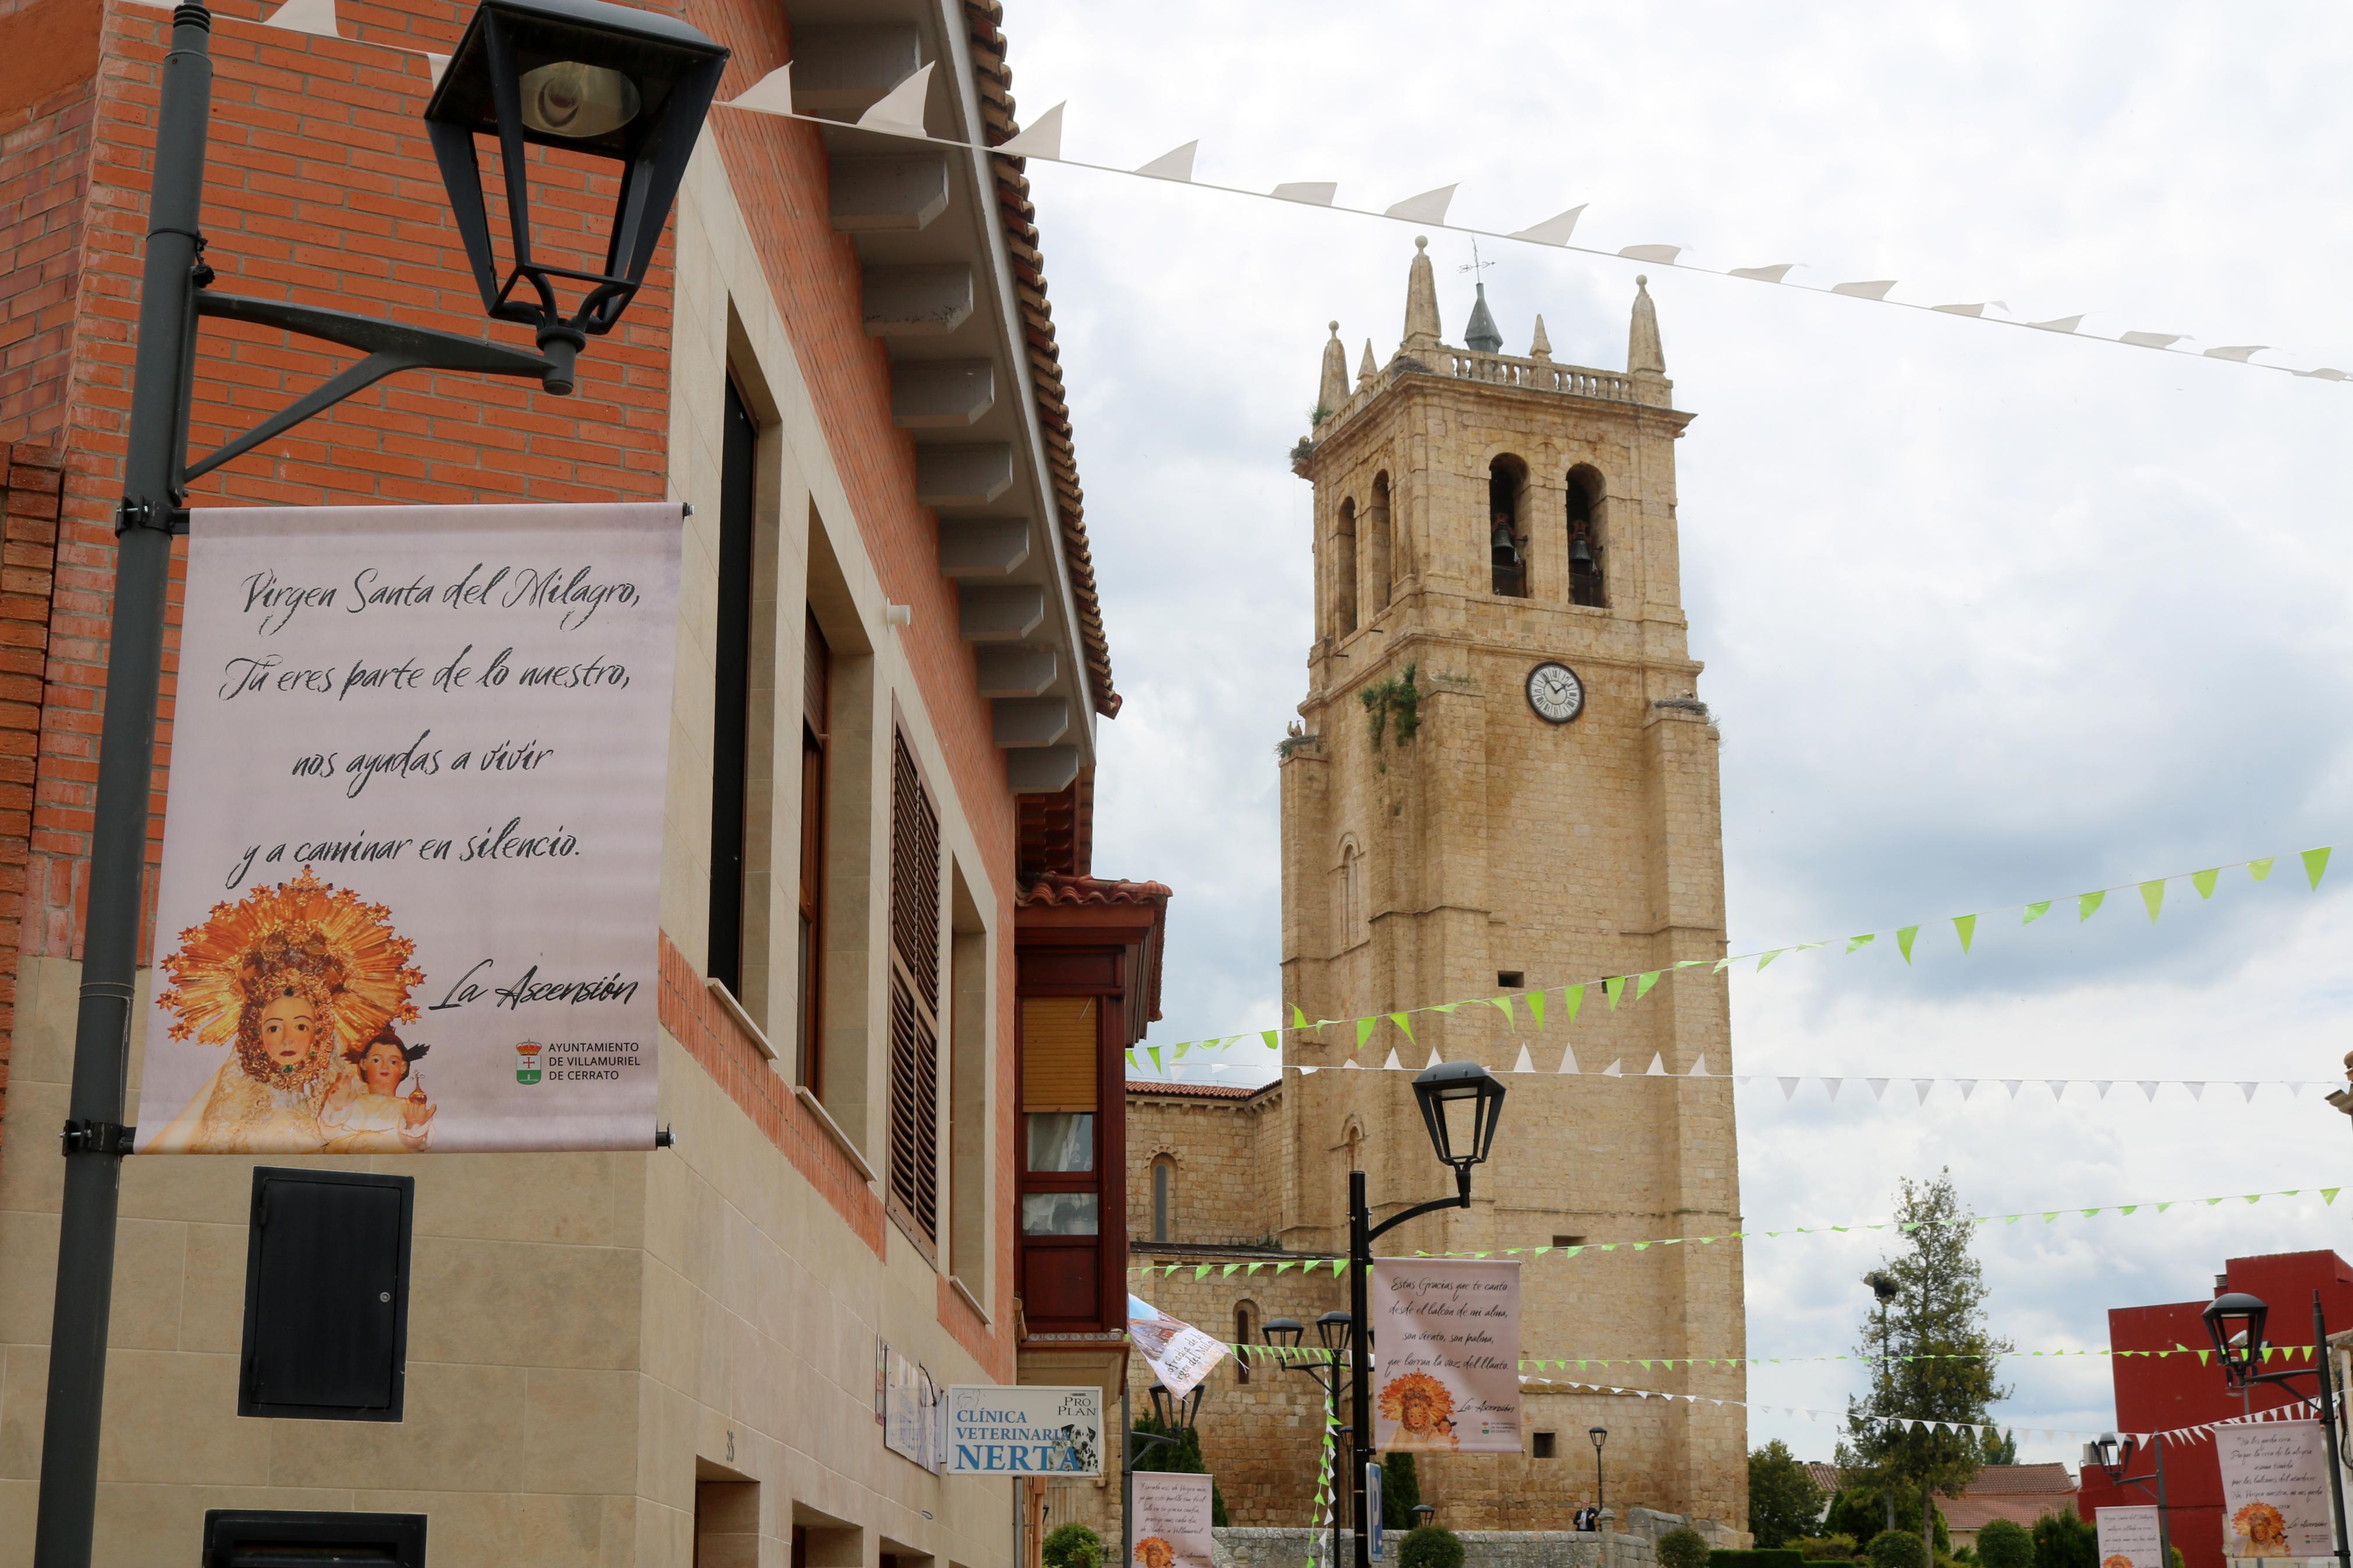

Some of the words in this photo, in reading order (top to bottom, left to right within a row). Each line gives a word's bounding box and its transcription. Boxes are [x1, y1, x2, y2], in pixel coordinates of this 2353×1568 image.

[242, 568, 337, 635] Virgen
[347, 568, 435, 613] Santa
[442, 563, 510, 609] del
[502, 566, 640, 631] Milagro,
[278, 668, 335, 692] eres
[339, 657, 424, 701] parte
[432, 644, 473, 692] de
[475, 647, 513, 687] lo
[519, 655, 630, 689] nuestro,
[292, 752, 338, 778] nos
[346, 729, 442, 799] ayudas
[451, 751, 471, 770] a
[481, 739, 553, 771] vivir
[225, 845, 261, 890] y
[266, 843, 286, 862] a
[294, 830, 413, 863] caminar
[419, 840, 452, 860] en
[459, 817, 579, 862] silencio.
[428, 959, 494, 1010] La
[495, 965, 638, 1010] Ascensión
[549, 1043, 638, 1052] AYUNTAMIENTO
[549, 1057, 563, 1066] DE
[567, 1057, 641, 1066] VILLAMURIEL
[549, 1071, 563, 1080] DE
[568, 1071, 619, 1080] CERRATO
[1391, 1277, 1415, 1291] Estas
[1417, 1277, 1453, 1296] Gracias
[1453, 1283, 1470, 1302] que
[1473, 1281, 1482, 1290] te
[1484, 1281, 1507, 1291] canto
[1389, 1300, 1414, 1315] desde
[1417, 1303, 1429, 1315] el
[1428, 1302, 1454, 1315] balcón
[1457, 1302, 1468, 1317] de
[1485, 1304, 1507, 1318] alma,
[1419, 1331, 1445, 1342] viento,
[1464, 1331, 1493, 1346] palma,
[1165, 1347, 1191, 1375] ofradía
[1385, 1359, 1401, 1378] que
[1405, 1352, 1430, 1366] borran
[1433, 1354, 1442, 1366] la
[1445, 1359, 1461, 1368] voz
[1463, 1355, 1482, 1370] del
[1480, 1357, 1509, 1370] llanto.
[1064, 1396, 1091, 1406] PRO
[1457, 1398, 1474, 1412] La
[1475, 1400, 1514, 1413] Ascensión
[957, 1407, 1028, 1424] CLÍNICA
[1057, 1406, 1096, 1416] PLAN
[956, 1427, 1070, 1441] VETERINARIA
[955, 1444, 1083, 1471] NERTA
